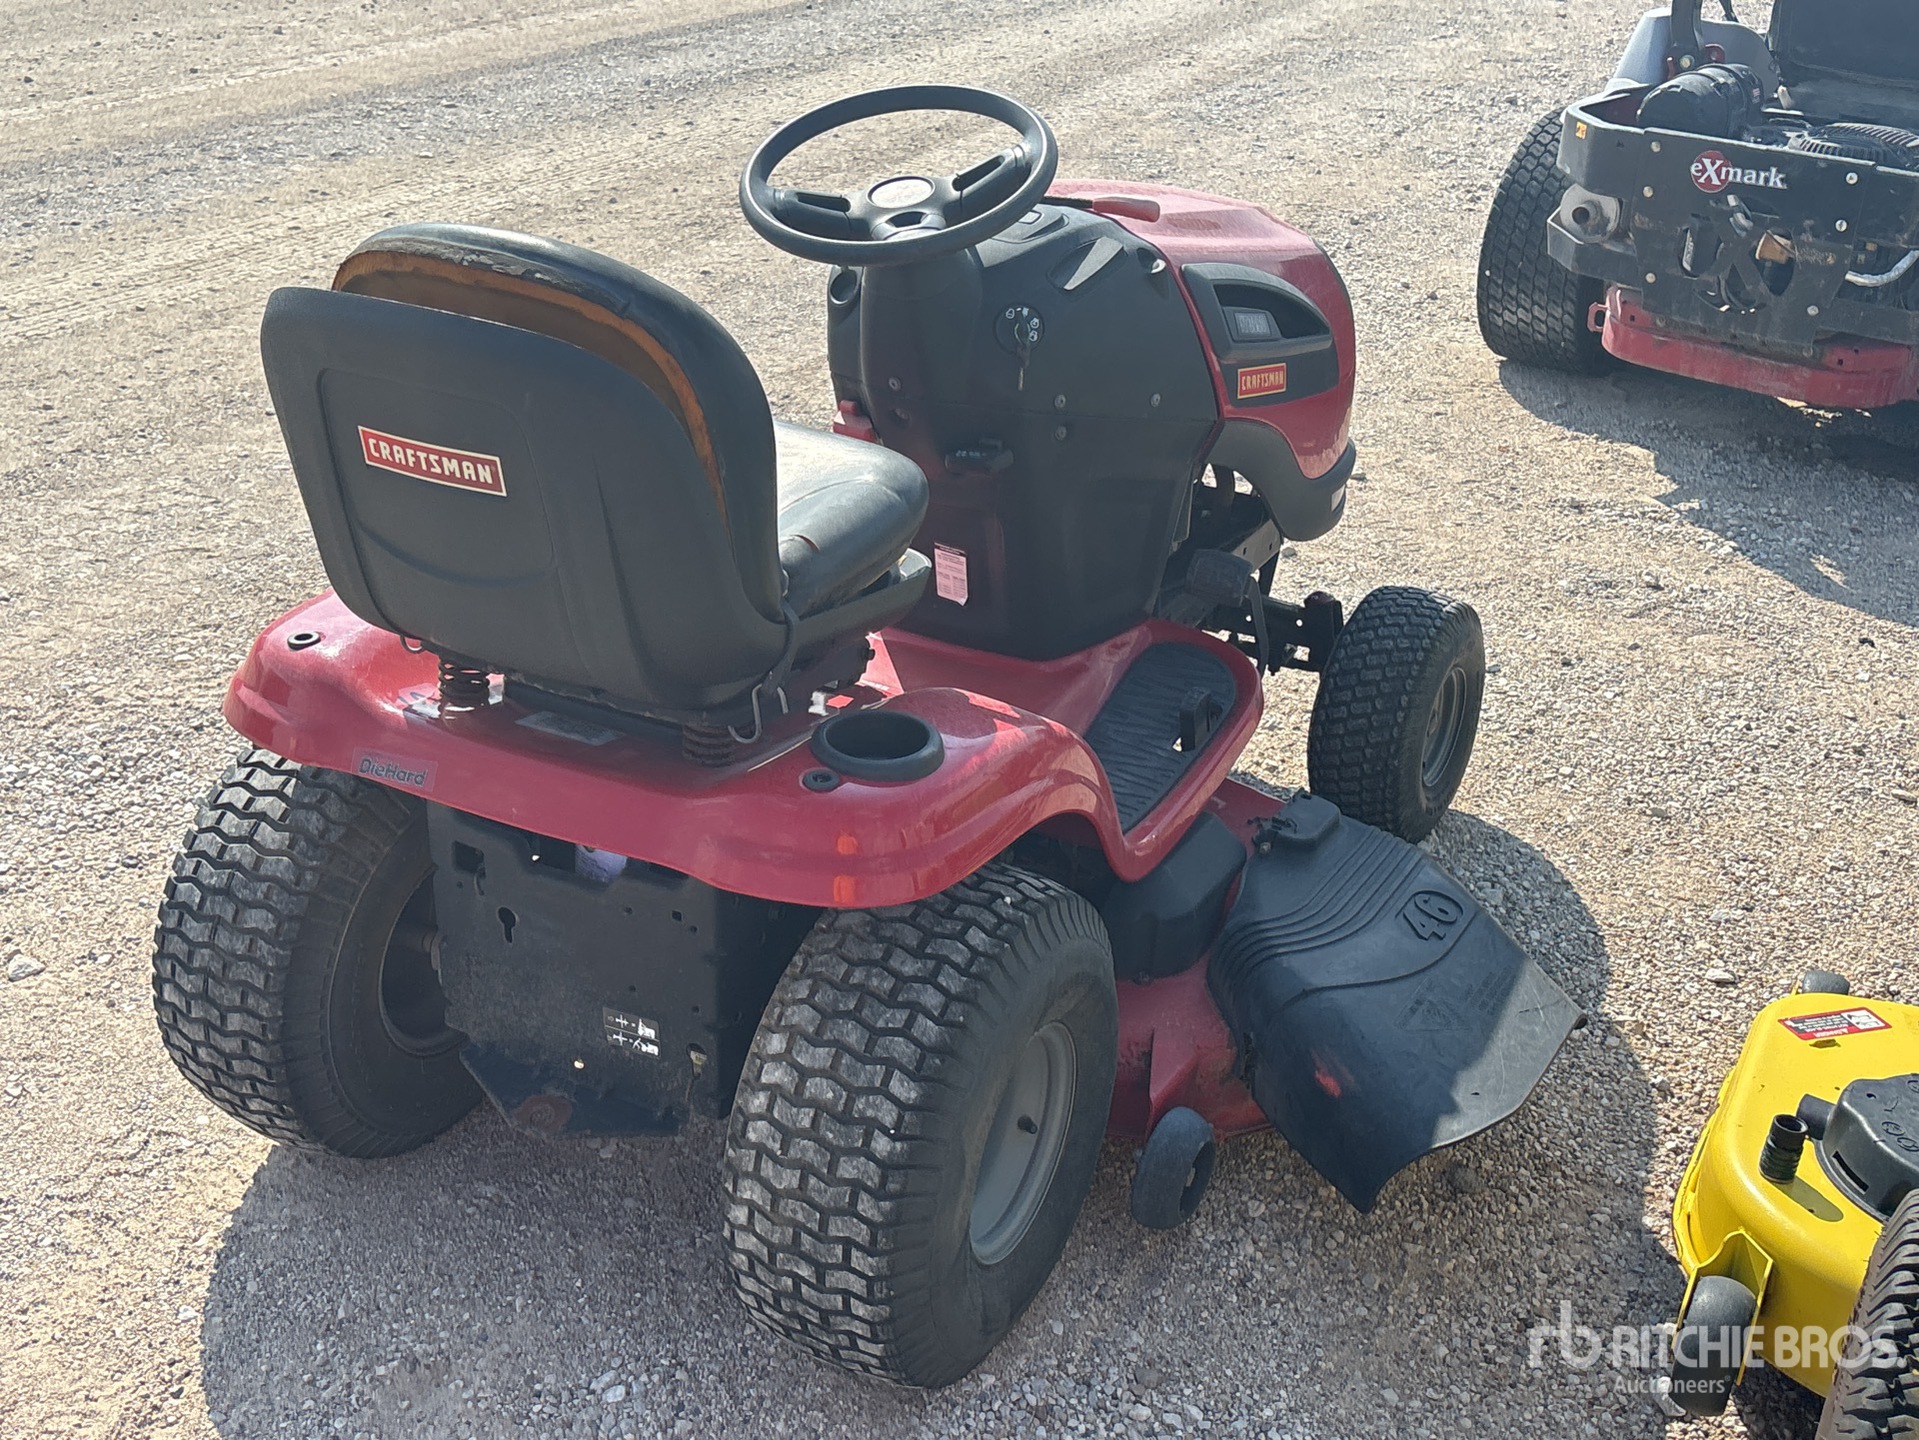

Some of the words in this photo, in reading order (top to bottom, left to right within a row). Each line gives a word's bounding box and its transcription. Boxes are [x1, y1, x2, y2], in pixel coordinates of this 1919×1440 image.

[1690, 158, 1788, 189] eXmark
[1241, 370, 1284, 391] CRAFTSMAN
[368, 437, 493, 484] CRAFTSMAN
[359, 757, 428, 787] DieHard
